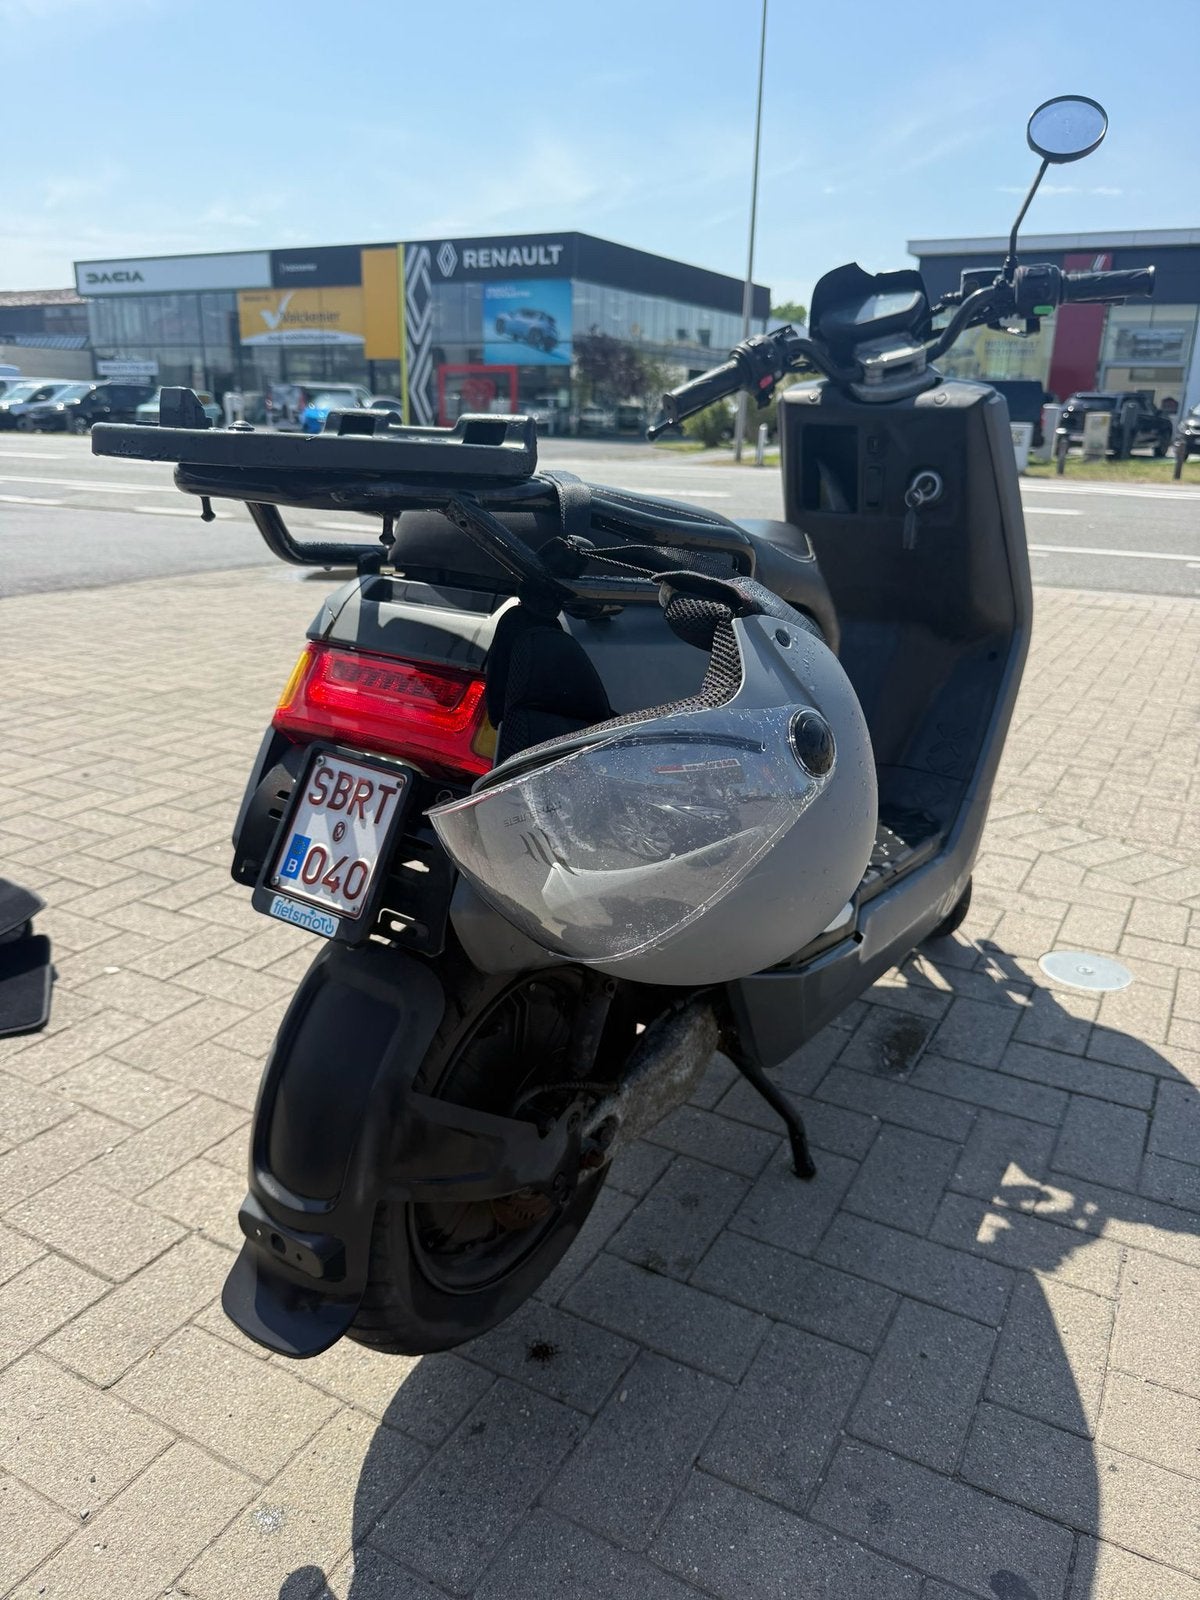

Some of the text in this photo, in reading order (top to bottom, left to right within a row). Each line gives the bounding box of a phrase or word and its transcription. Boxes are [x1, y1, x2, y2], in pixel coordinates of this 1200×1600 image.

[463, 245, 563, 269] RENAULT
[86, 270, 144, 284] DACIA
[308, 766, 398, 825] SBRT
[286, 858, 298, 873] B
[301, 845, 368, 901] 040
